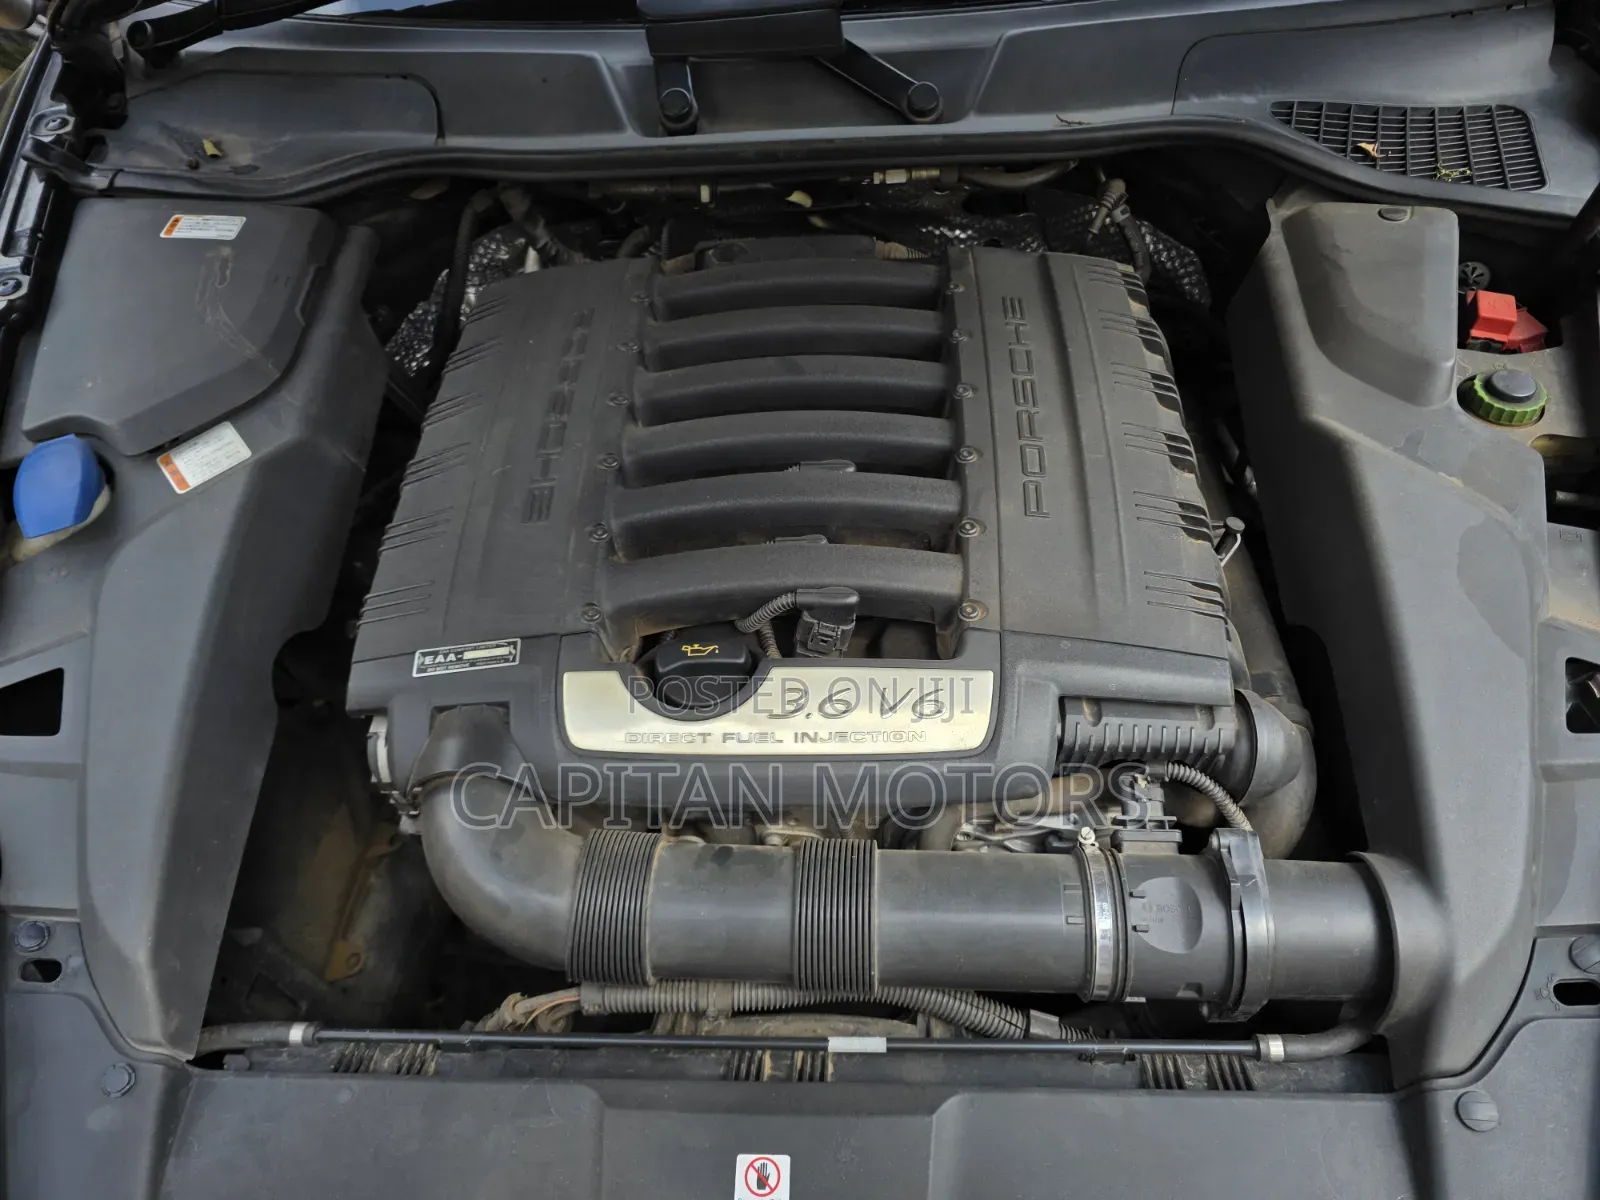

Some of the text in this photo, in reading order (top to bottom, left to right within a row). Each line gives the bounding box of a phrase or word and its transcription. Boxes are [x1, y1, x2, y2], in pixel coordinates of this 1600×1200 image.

[1002, 296, 1050, 518] PORSCHE
[879, 687, 945, 719] V6
[625, 731, 927, 744] DIRECT FUEL INJECTION
